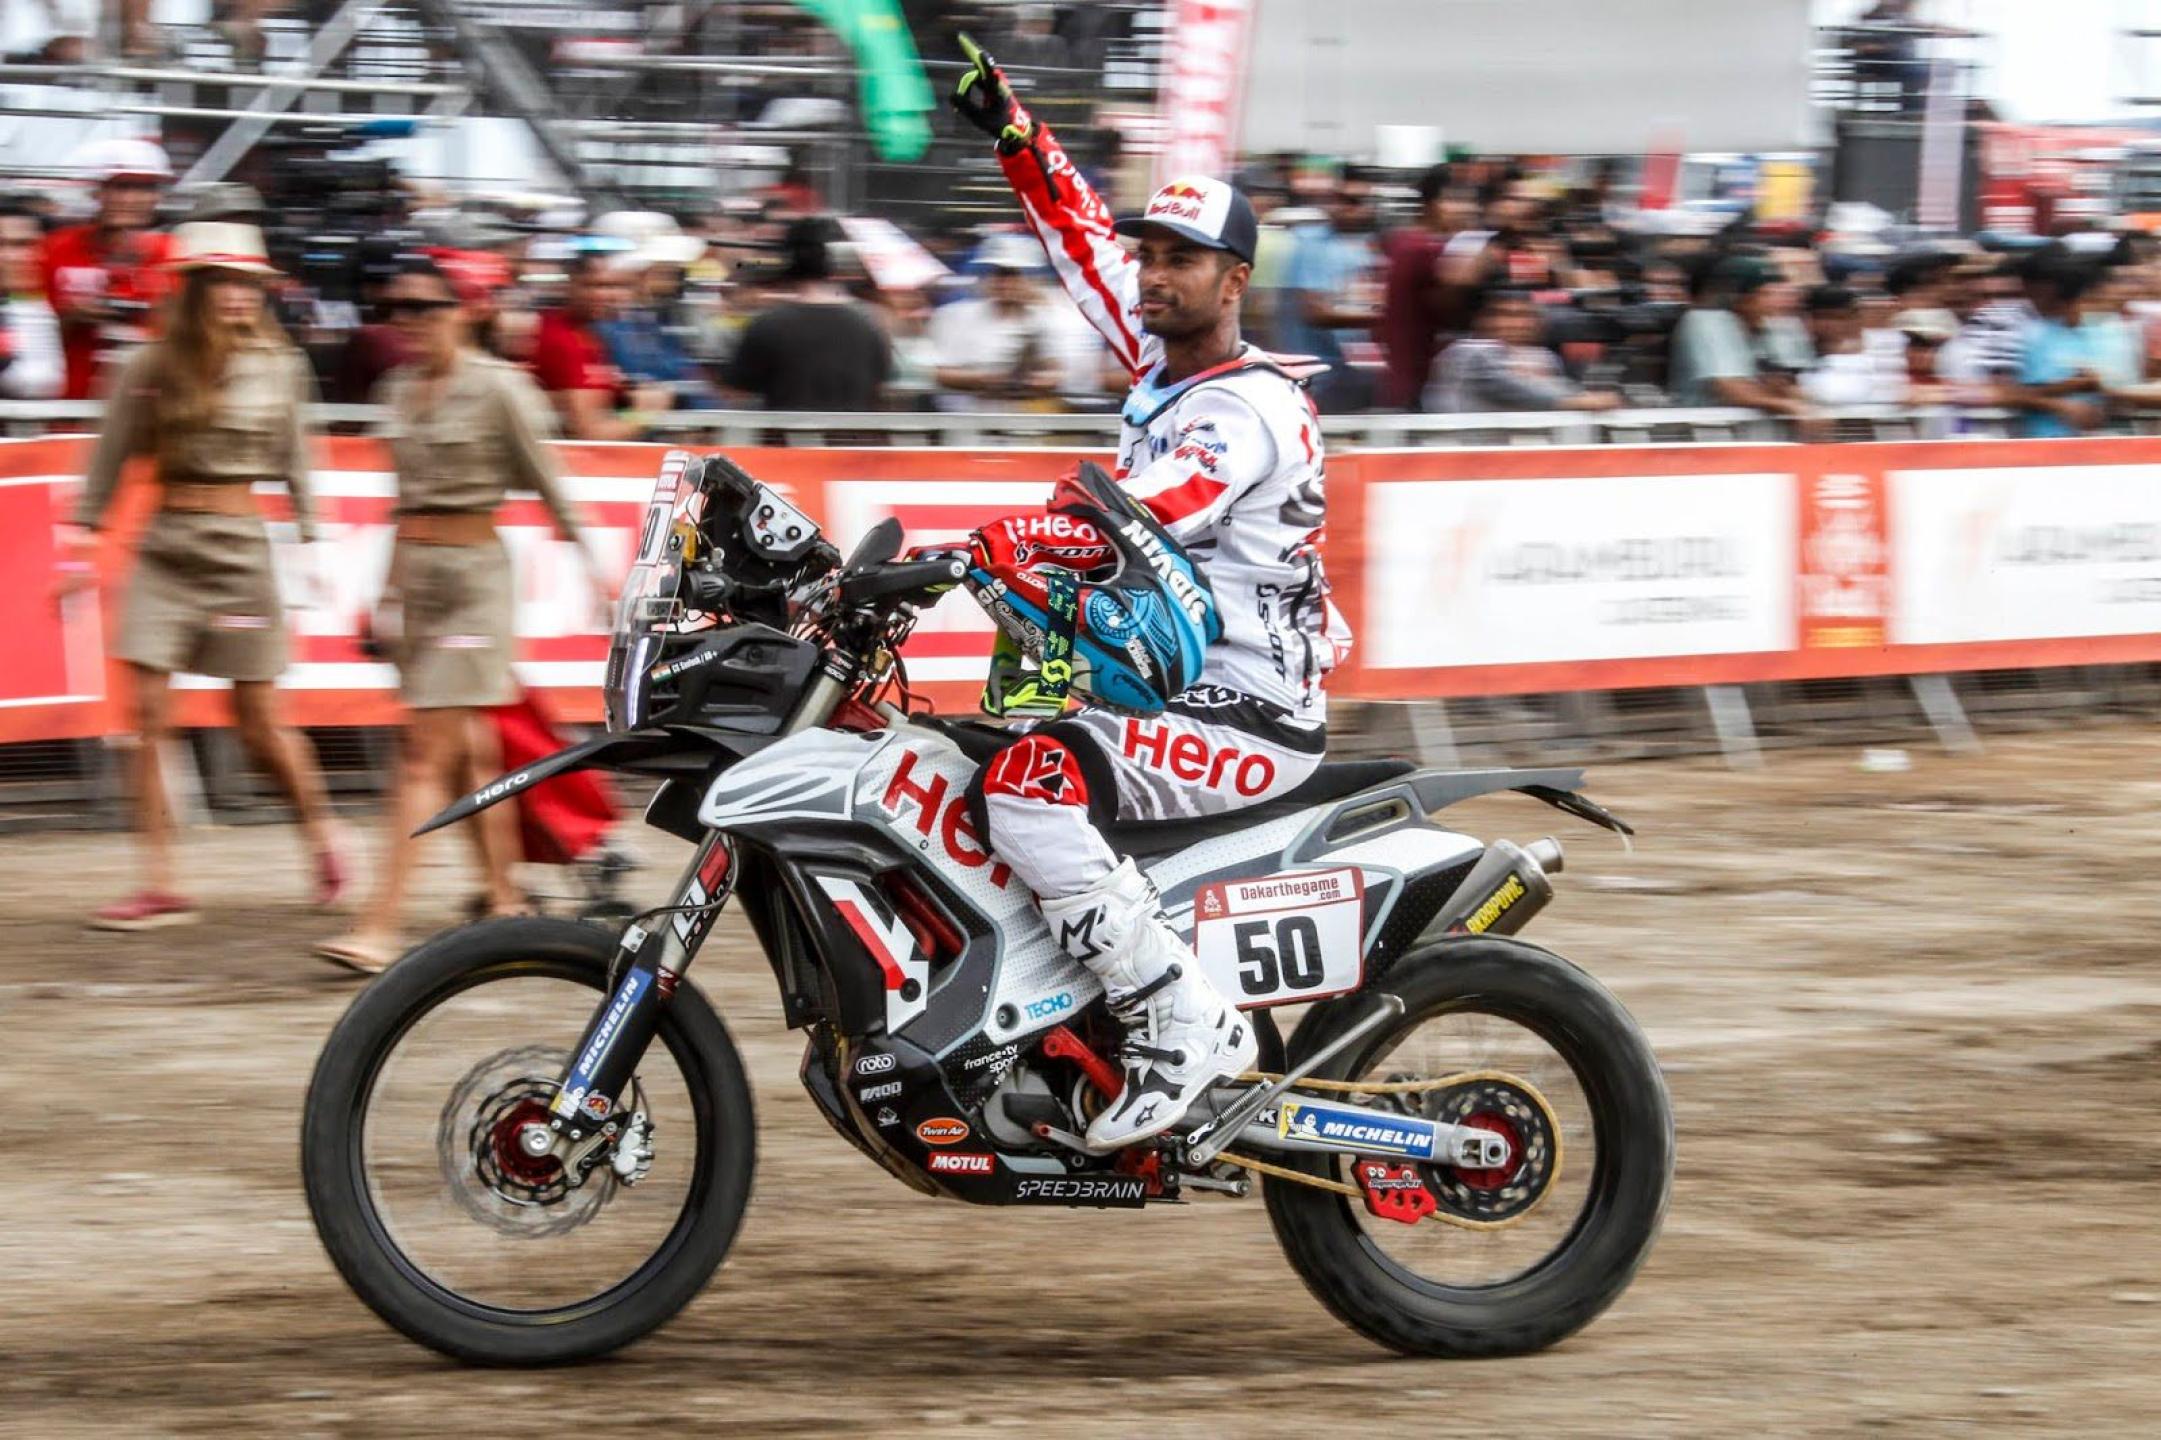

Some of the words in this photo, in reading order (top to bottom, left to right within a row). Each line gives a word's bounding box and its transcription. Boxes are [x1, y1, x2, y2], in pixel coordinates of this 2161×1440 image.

[1171, 202, 1202, 221] Bull
[1120, 519, 1207, 626] SIDVIN
[1123, 718, 1276, 798] Hero
[475, 772, 529, 805] Hero
[1240, 877, 1339, 901] Dakarthegame
[1233, 915, 1325, 996] 50
[1024, 992, 1074, 1020] TECHO
[578, 976, 640, 1076] MICHELIN
[861, 1056, 892, 1072] roto
[922, 1127, 947, 1137] Twin
[1322, 1121, 1433, 1148] MICHELIN
[932, 1155, 991, 1171] MOTUL
[1016, 1180, 1144, 1199] SPEEDBRAIN
